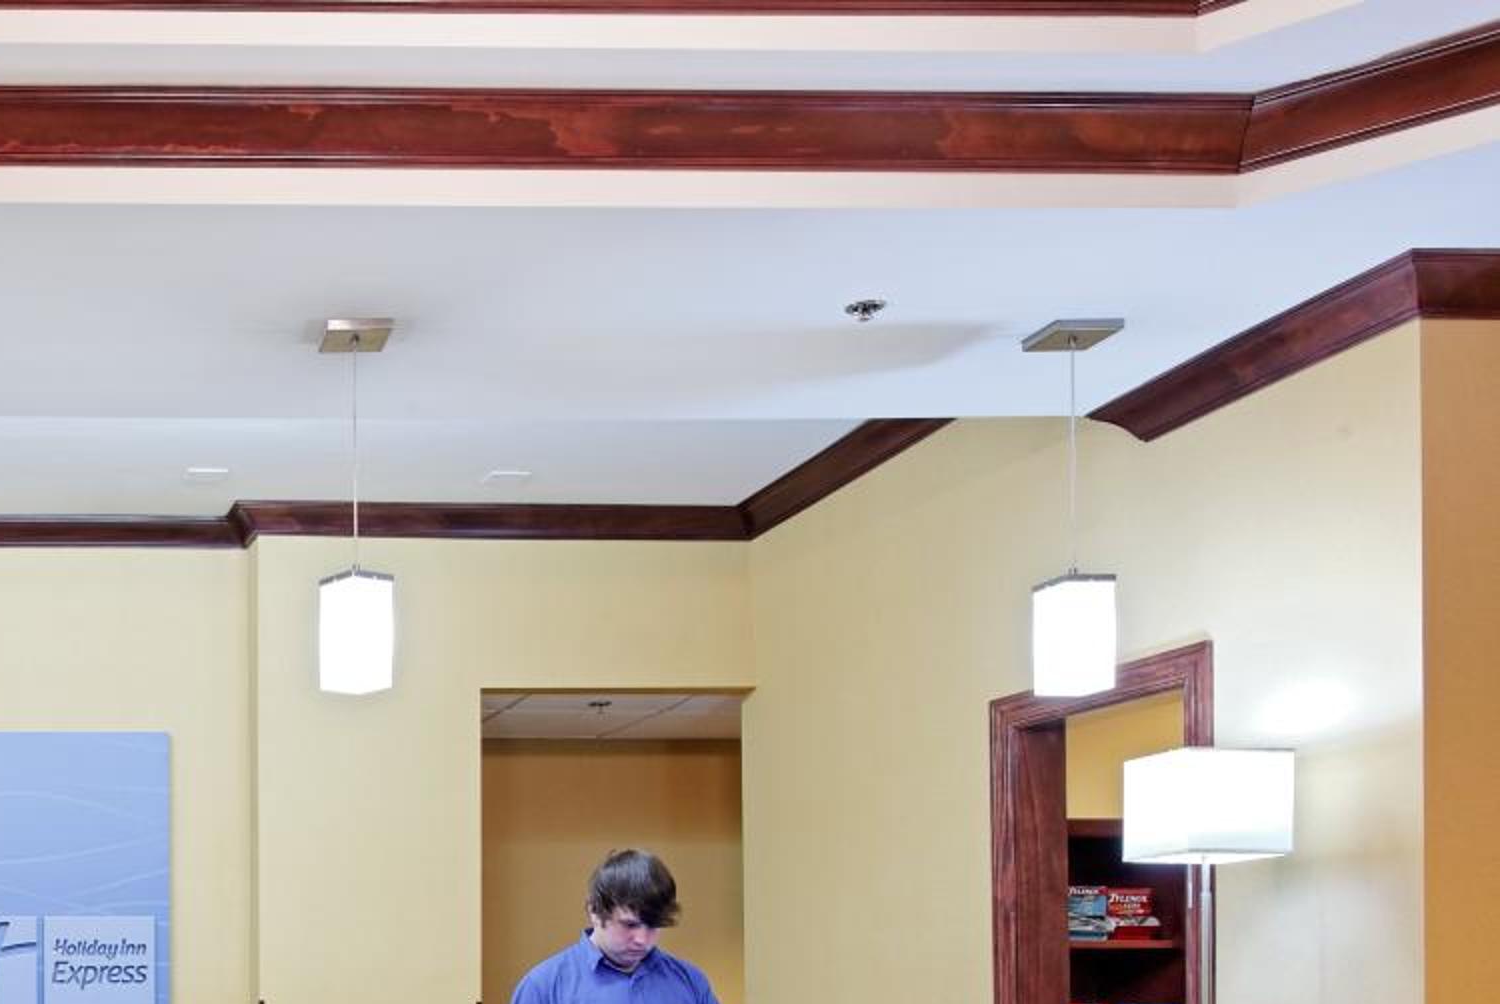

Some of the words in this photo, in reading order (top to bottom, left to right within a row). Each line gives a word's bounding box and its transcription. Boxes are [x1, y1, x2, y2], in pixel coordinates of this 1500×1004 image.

[53, 938, 117, 960] Holiday
[120, 938, 148, 956] Inn
[52, 961, 148, 990] Express
